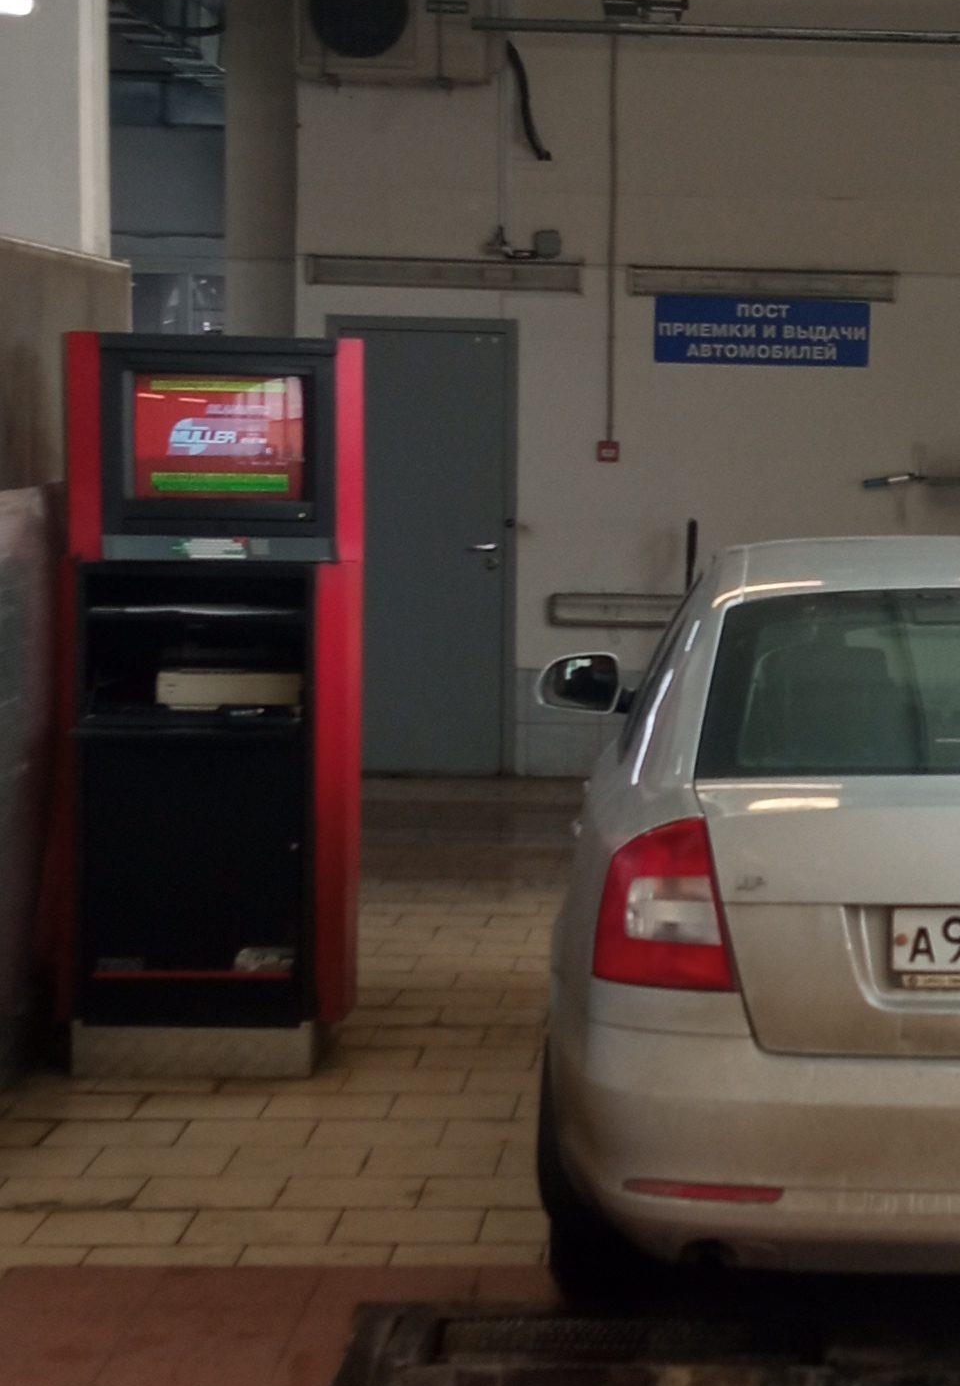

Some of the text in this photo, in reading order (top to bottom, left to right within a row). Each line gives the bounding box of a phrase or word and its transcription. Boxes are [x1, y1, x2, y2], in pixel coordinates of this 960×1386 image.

[736, 303, 791, 318] ПОСТ
[658, 322, 867, 341] ПРИЕМКИ И ВЫДАЧИ
[686, 342, 837, 360] АВТОМОБИЛЕЙ
